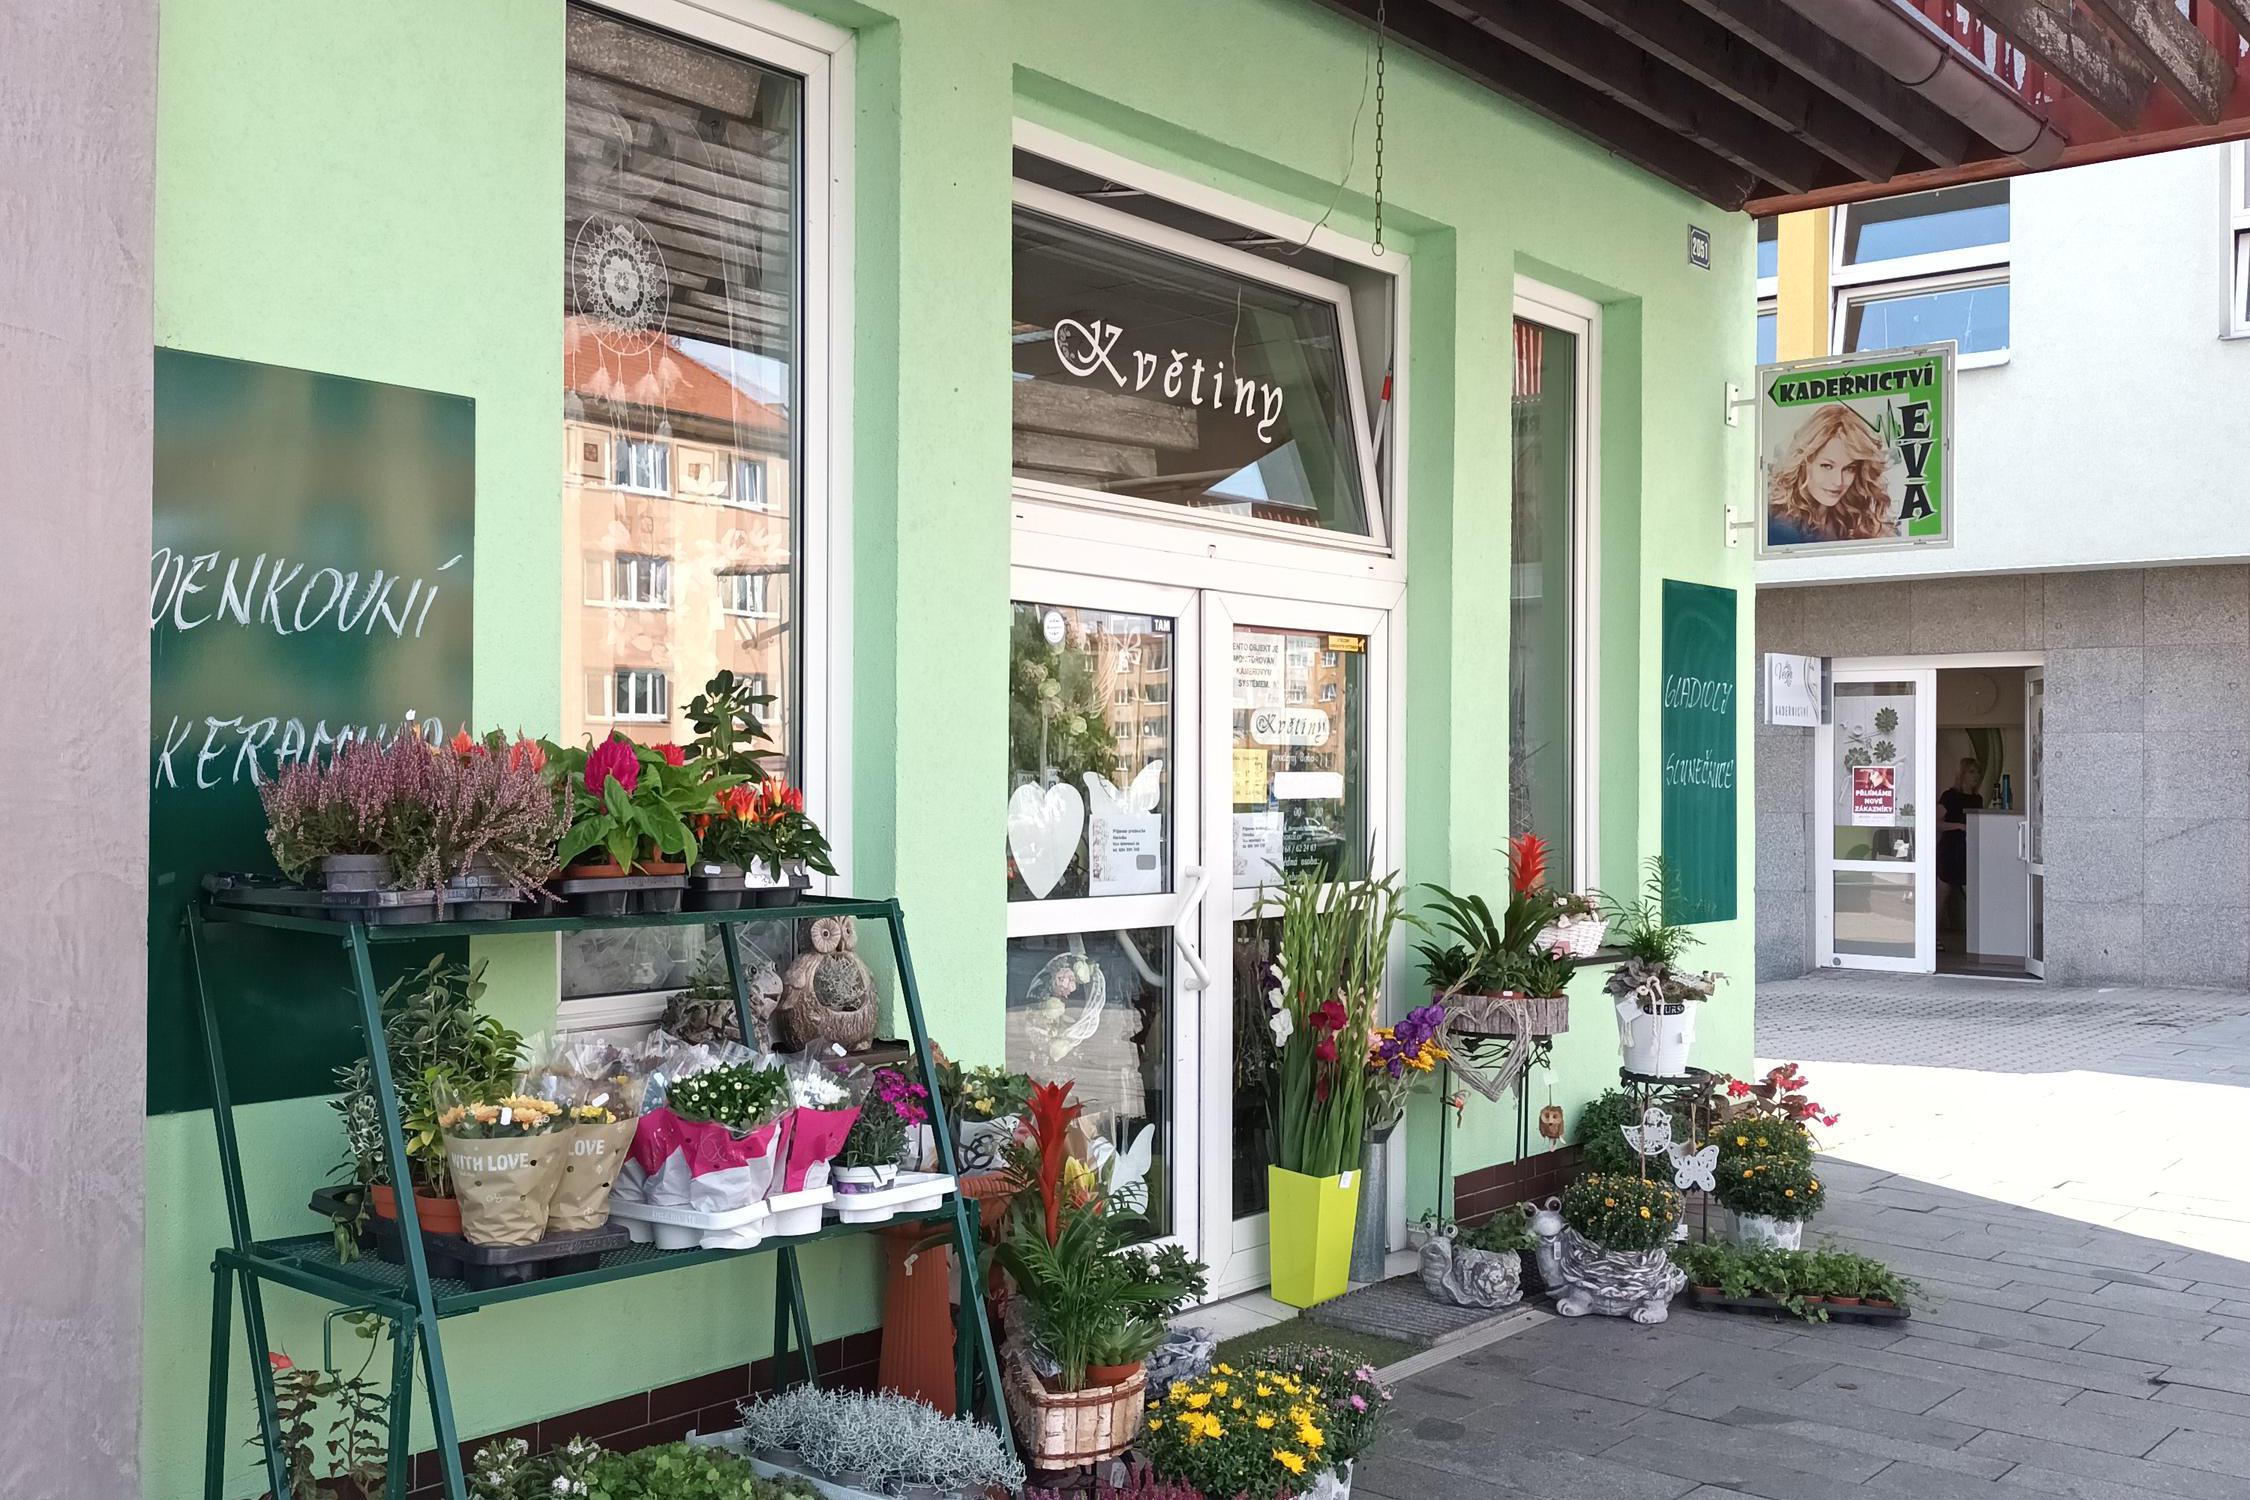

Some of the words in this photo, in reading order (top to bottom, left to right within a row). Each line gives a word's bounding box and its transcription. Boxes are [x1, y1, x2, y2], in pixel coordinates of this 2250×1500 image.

[1692, 237, 1708, 260] 2051
[1054, 318, 1284, 443] Květiny
[1779, 361, 1934, 403] KADEŘNICTVÍ
[1898, 401, 1936, 522] EVA
[1154, 619, 1170, 632] TAM
[1232, 642, 1248, 651] ENTO
[1256, 713, 1326, 743] Květiny
[568, 1139, 605, 1156] OVE
[451, 1153, 484, 1173] WITH
[488, 1152, 529, 1172] LOVE
